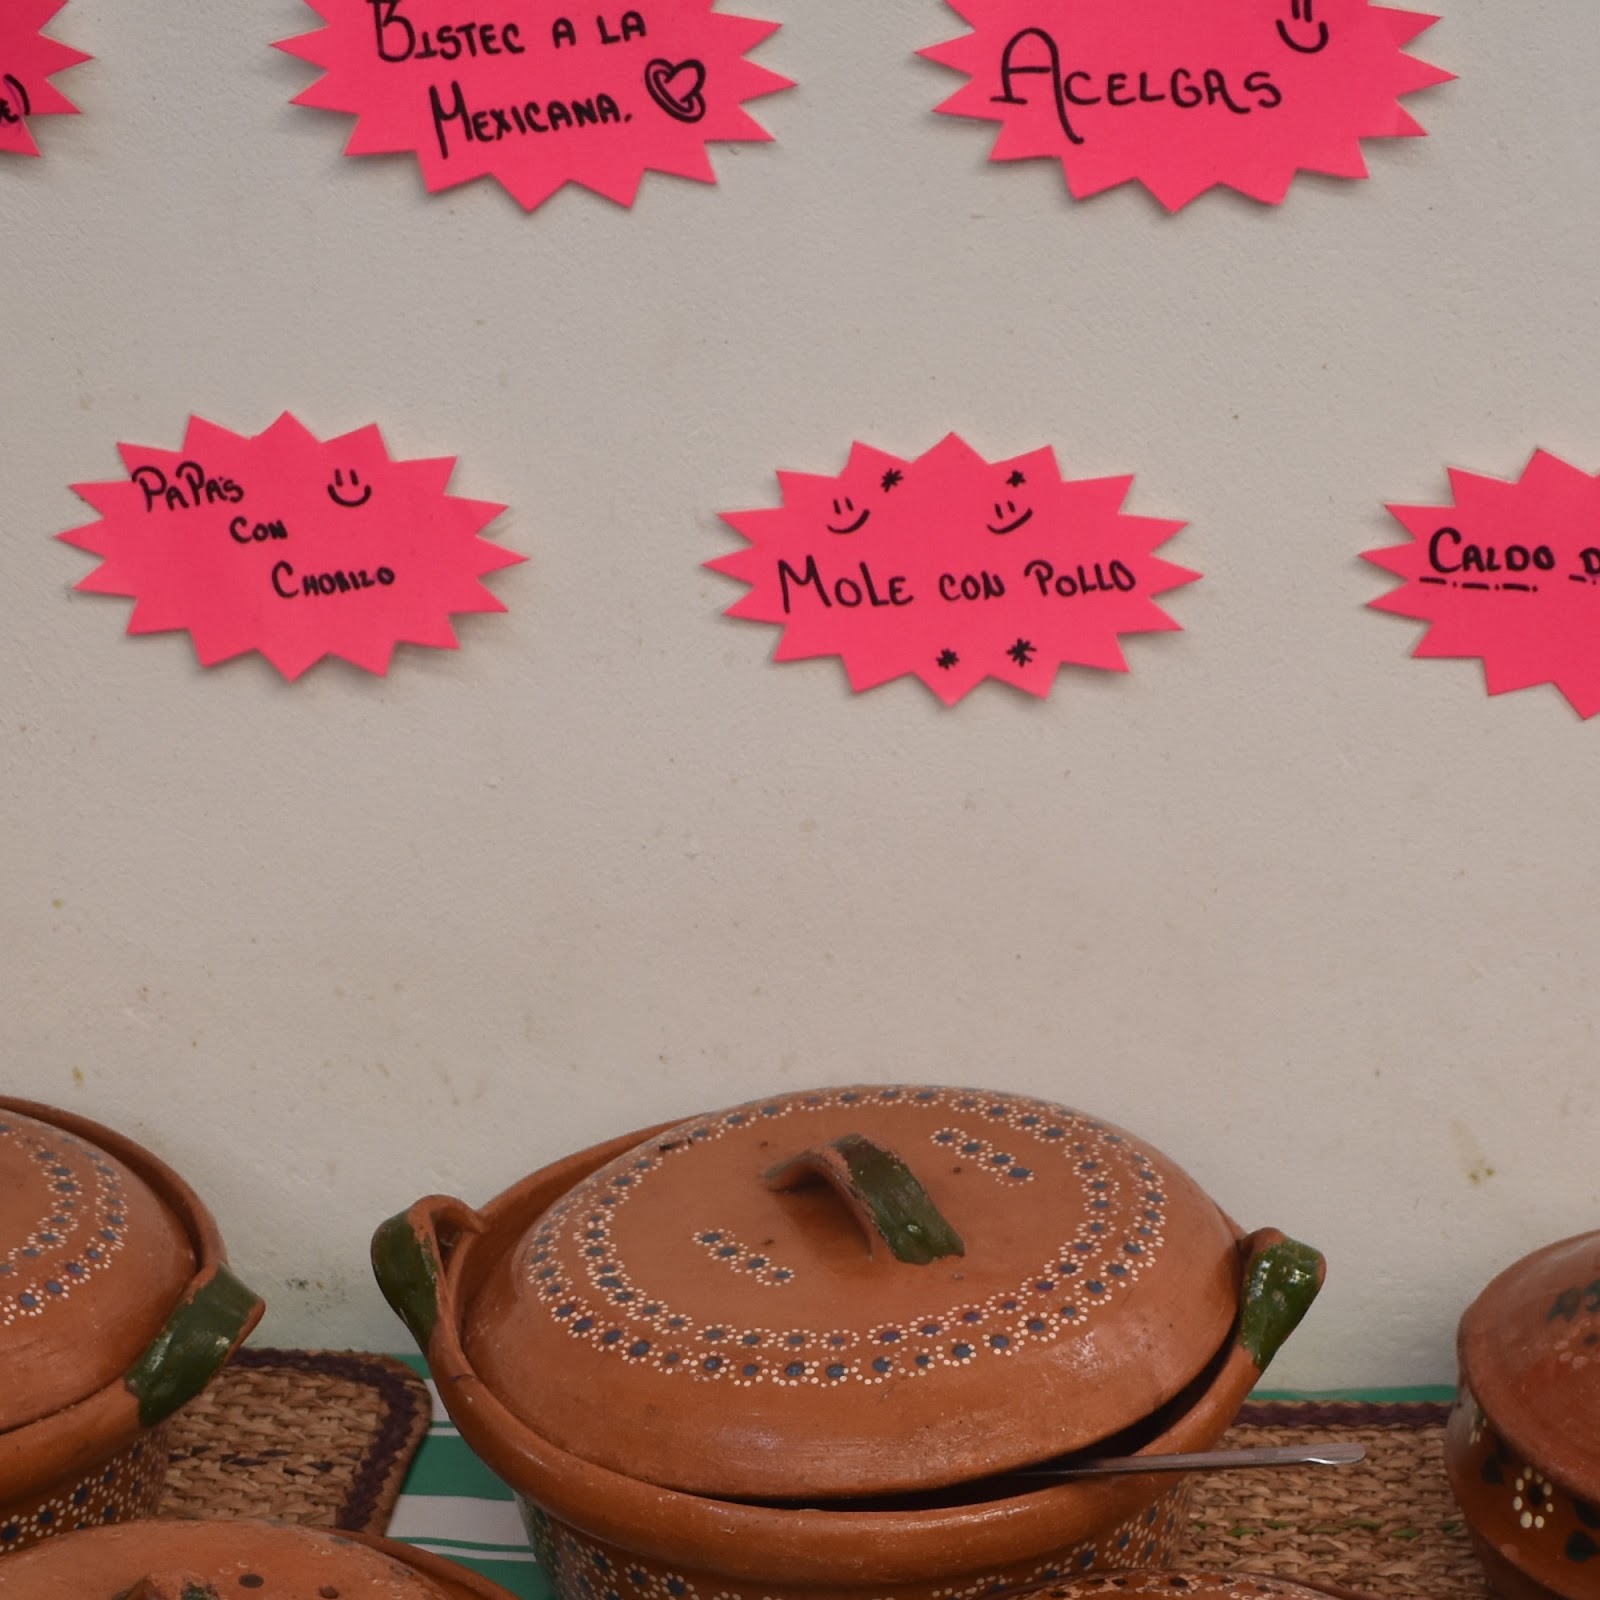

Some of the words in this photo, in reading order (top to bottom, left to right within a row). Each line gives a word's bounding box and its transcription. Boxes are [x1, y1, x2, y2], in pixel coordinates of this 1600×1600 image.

[365, 0, 526, 63] BISTEC
[551, 17, 577, 49] A
[596, 10, 648, 45] LA
[989, 27, 1283, 145] ACELGAS
[428, 80, 633, 160] MEXICANA.
[229, 515, 288, 544] CON
[1428, 526, 1556, 574] CALDO
[271, 560, 396, 599] CHORIZO
[777, 554, 915, 614] MOLE
[938, 570, 1006, 602] CON
[1023, 559, 1137, 598] POLLO
